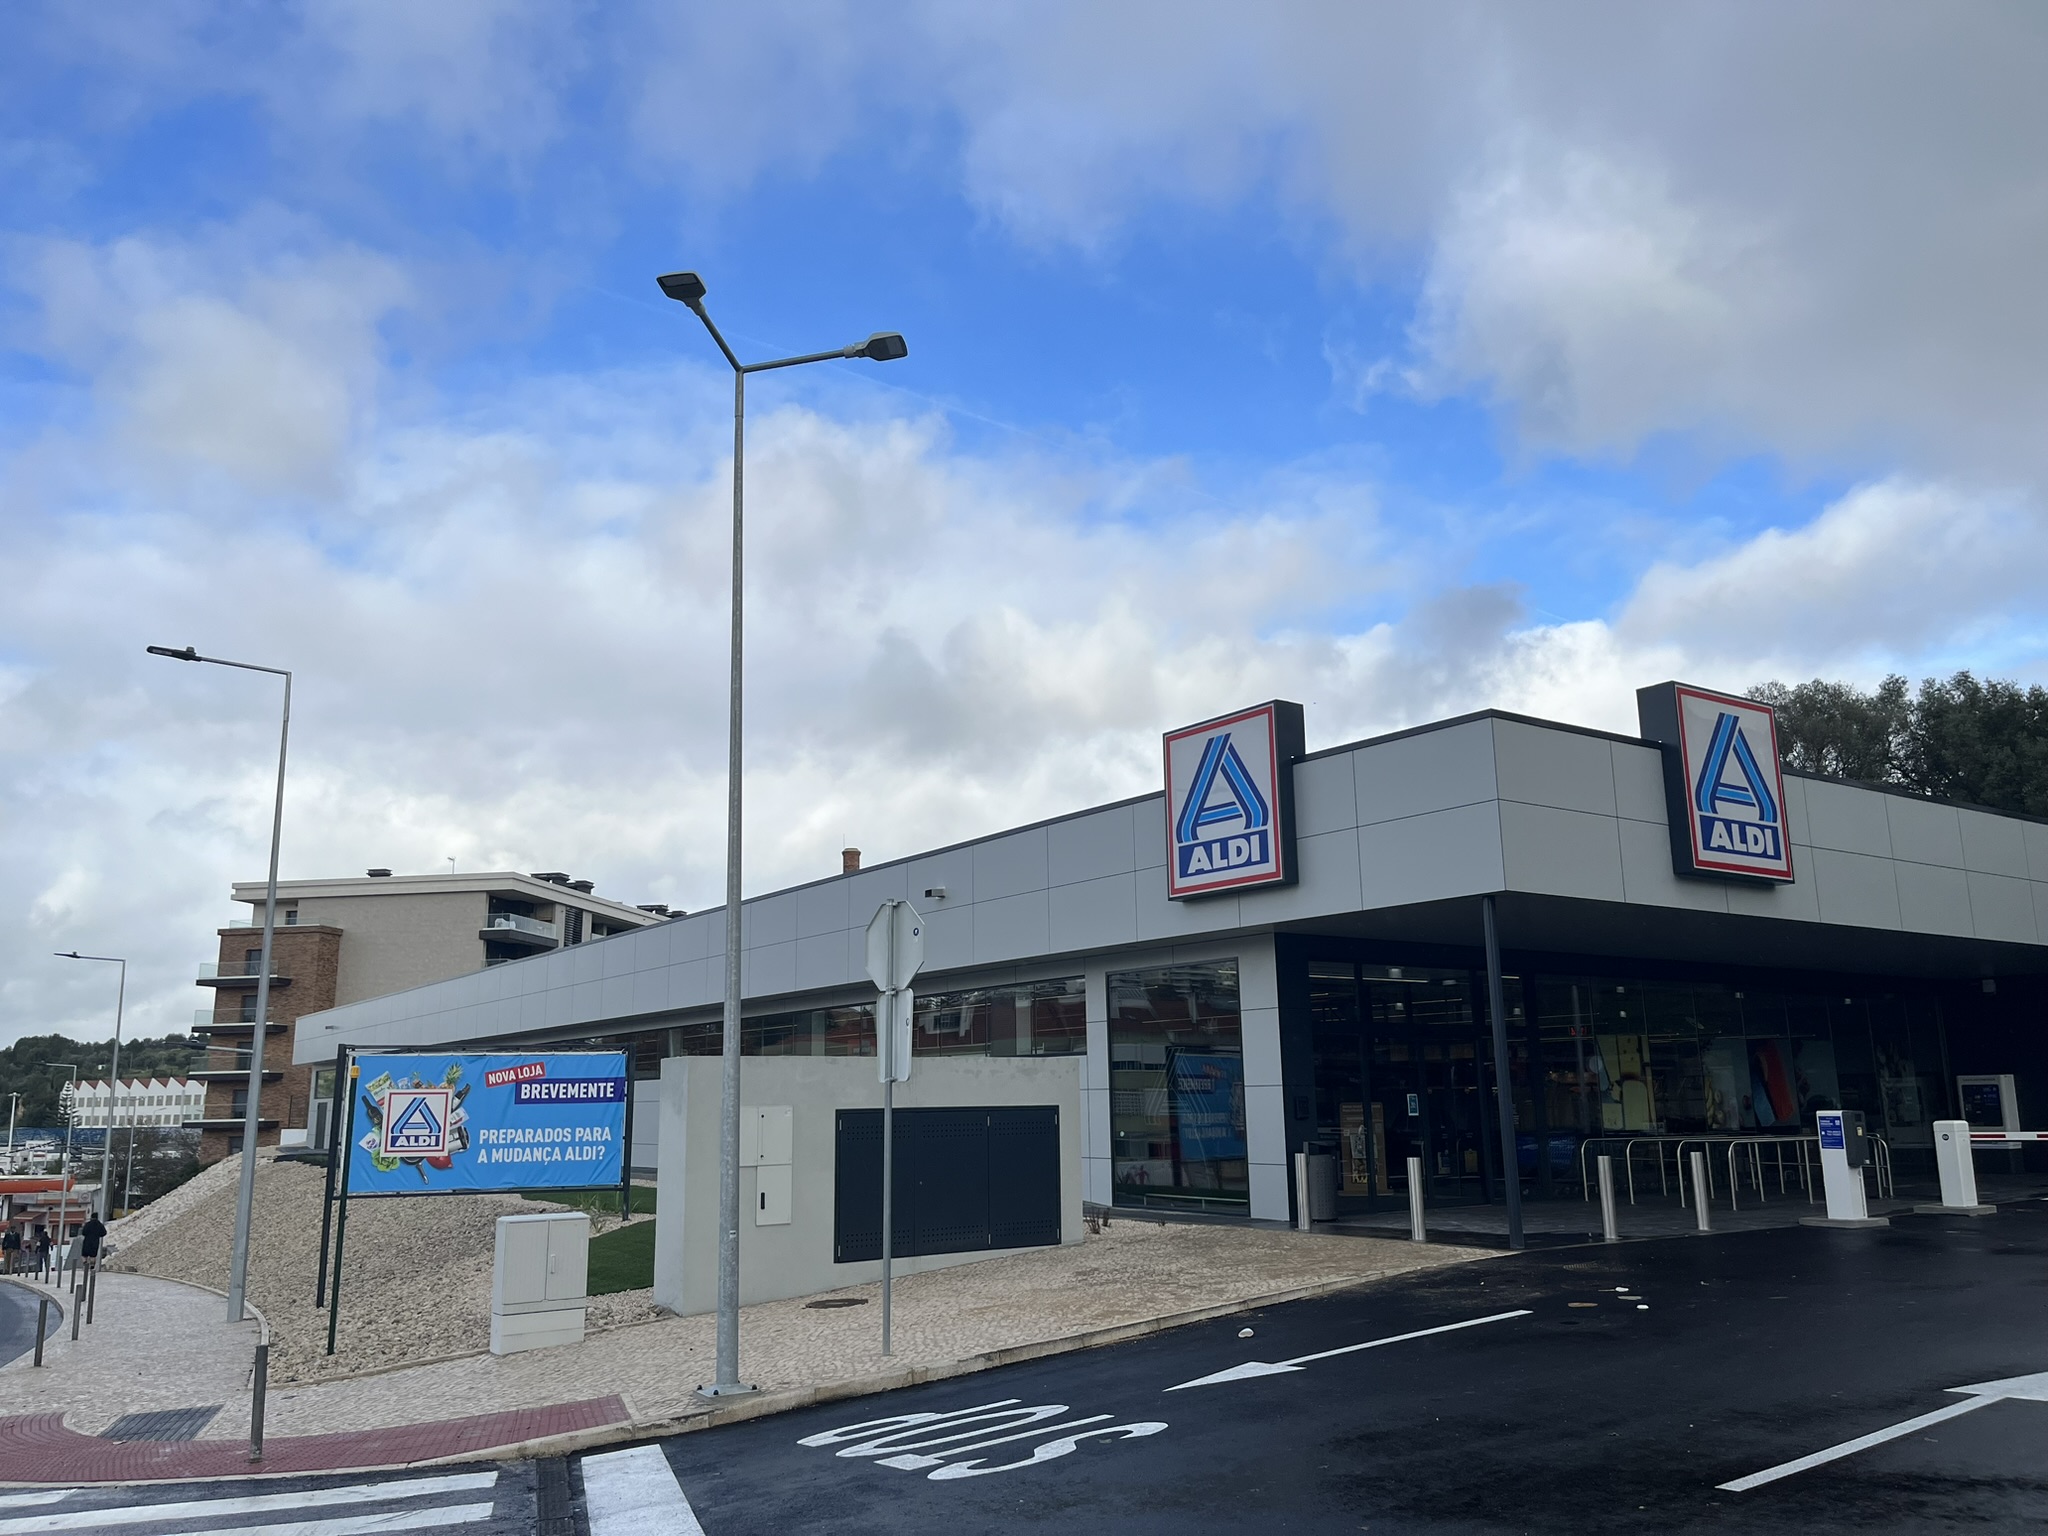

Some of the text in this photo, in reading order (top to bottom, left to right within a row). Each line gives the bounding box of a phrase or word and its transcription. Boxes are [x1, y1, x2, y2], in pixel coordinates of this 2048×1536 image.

[1709, 820, 1775, 857] ALDI
[1187, 833, 1262, 874] ALDI
[488, 1064, 543, 1085] NOVA LOJA
[521, 1082, 615, 1099] BREVEMENTE
[395, 1135, 437, 1147] ALDI
[479, 1127, 612, 1144] PREPARADOS PARA
[478, 1145, 606, 1165] A MUDANÇA ALDI?
[796, 1399, 1169, 1481] STOP
